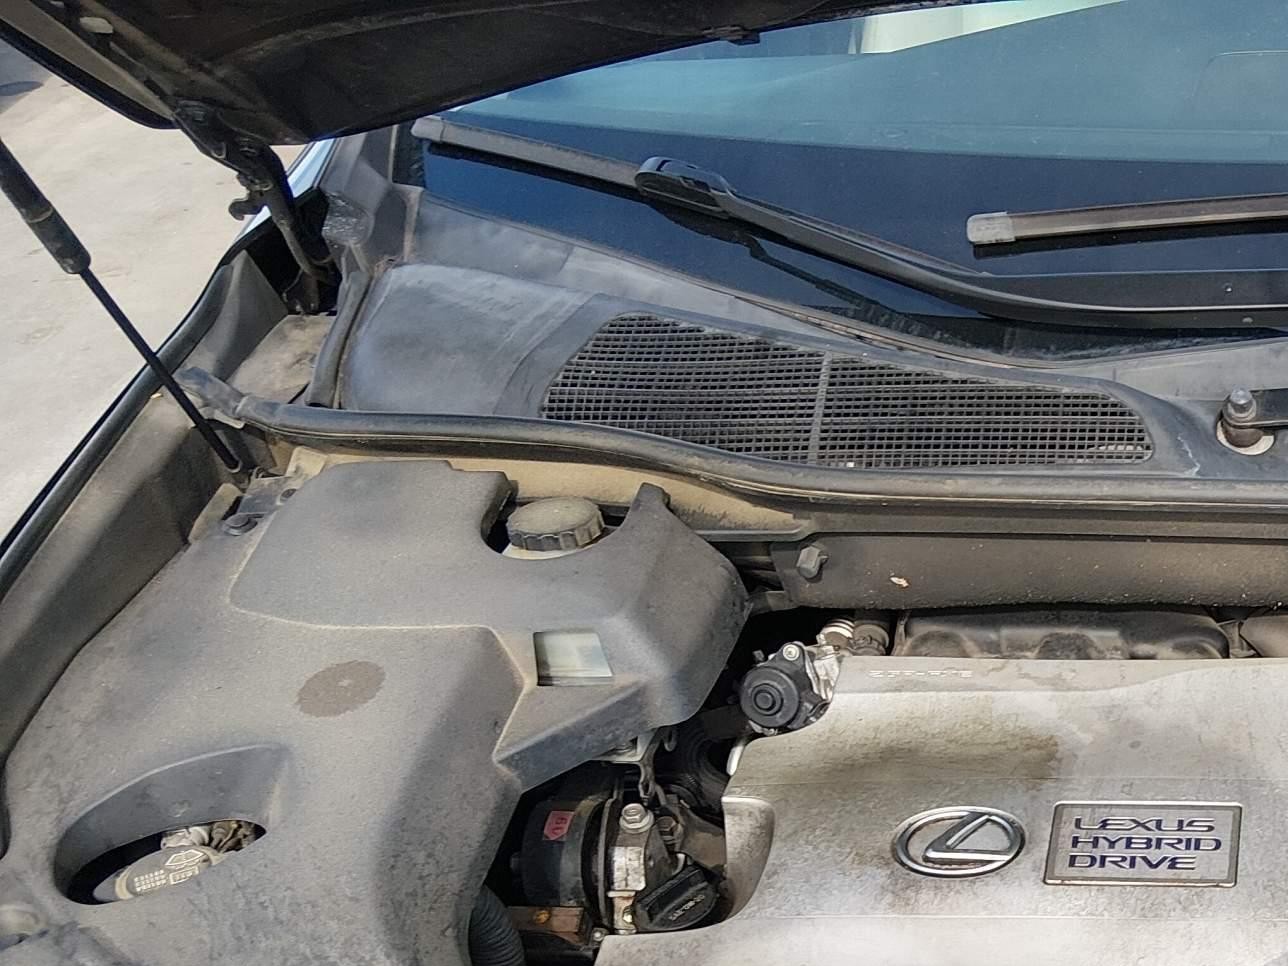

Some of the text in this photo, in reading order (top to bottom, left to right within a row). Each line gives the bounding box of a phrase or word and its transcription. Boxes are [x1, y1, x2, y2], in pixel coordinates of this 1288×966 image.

[1074, 816, 1215, 832] LEXUS
[1071, 834, 1222, 851] HYBRID
[1068, 853, 1197, 870] DRIVE
